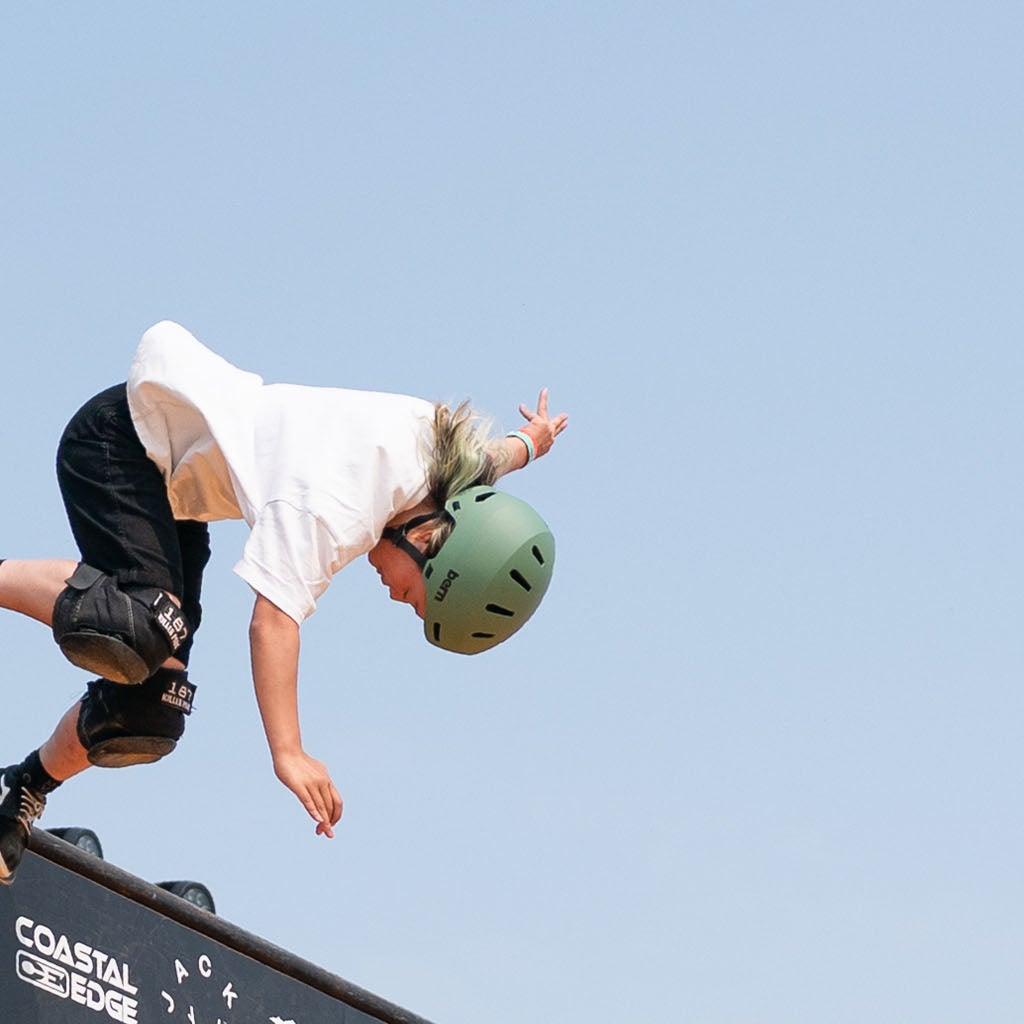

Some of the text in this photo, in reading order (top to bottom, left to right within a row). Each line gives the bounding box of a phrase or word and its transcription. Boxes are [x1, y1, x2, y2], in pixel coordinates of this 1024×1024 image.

[434, 569, 459, 602] bern
[164, 607, 188, 640] 187
[167, 681, 193, 701] 187
[15, 916, 138, 995] COASTAL
